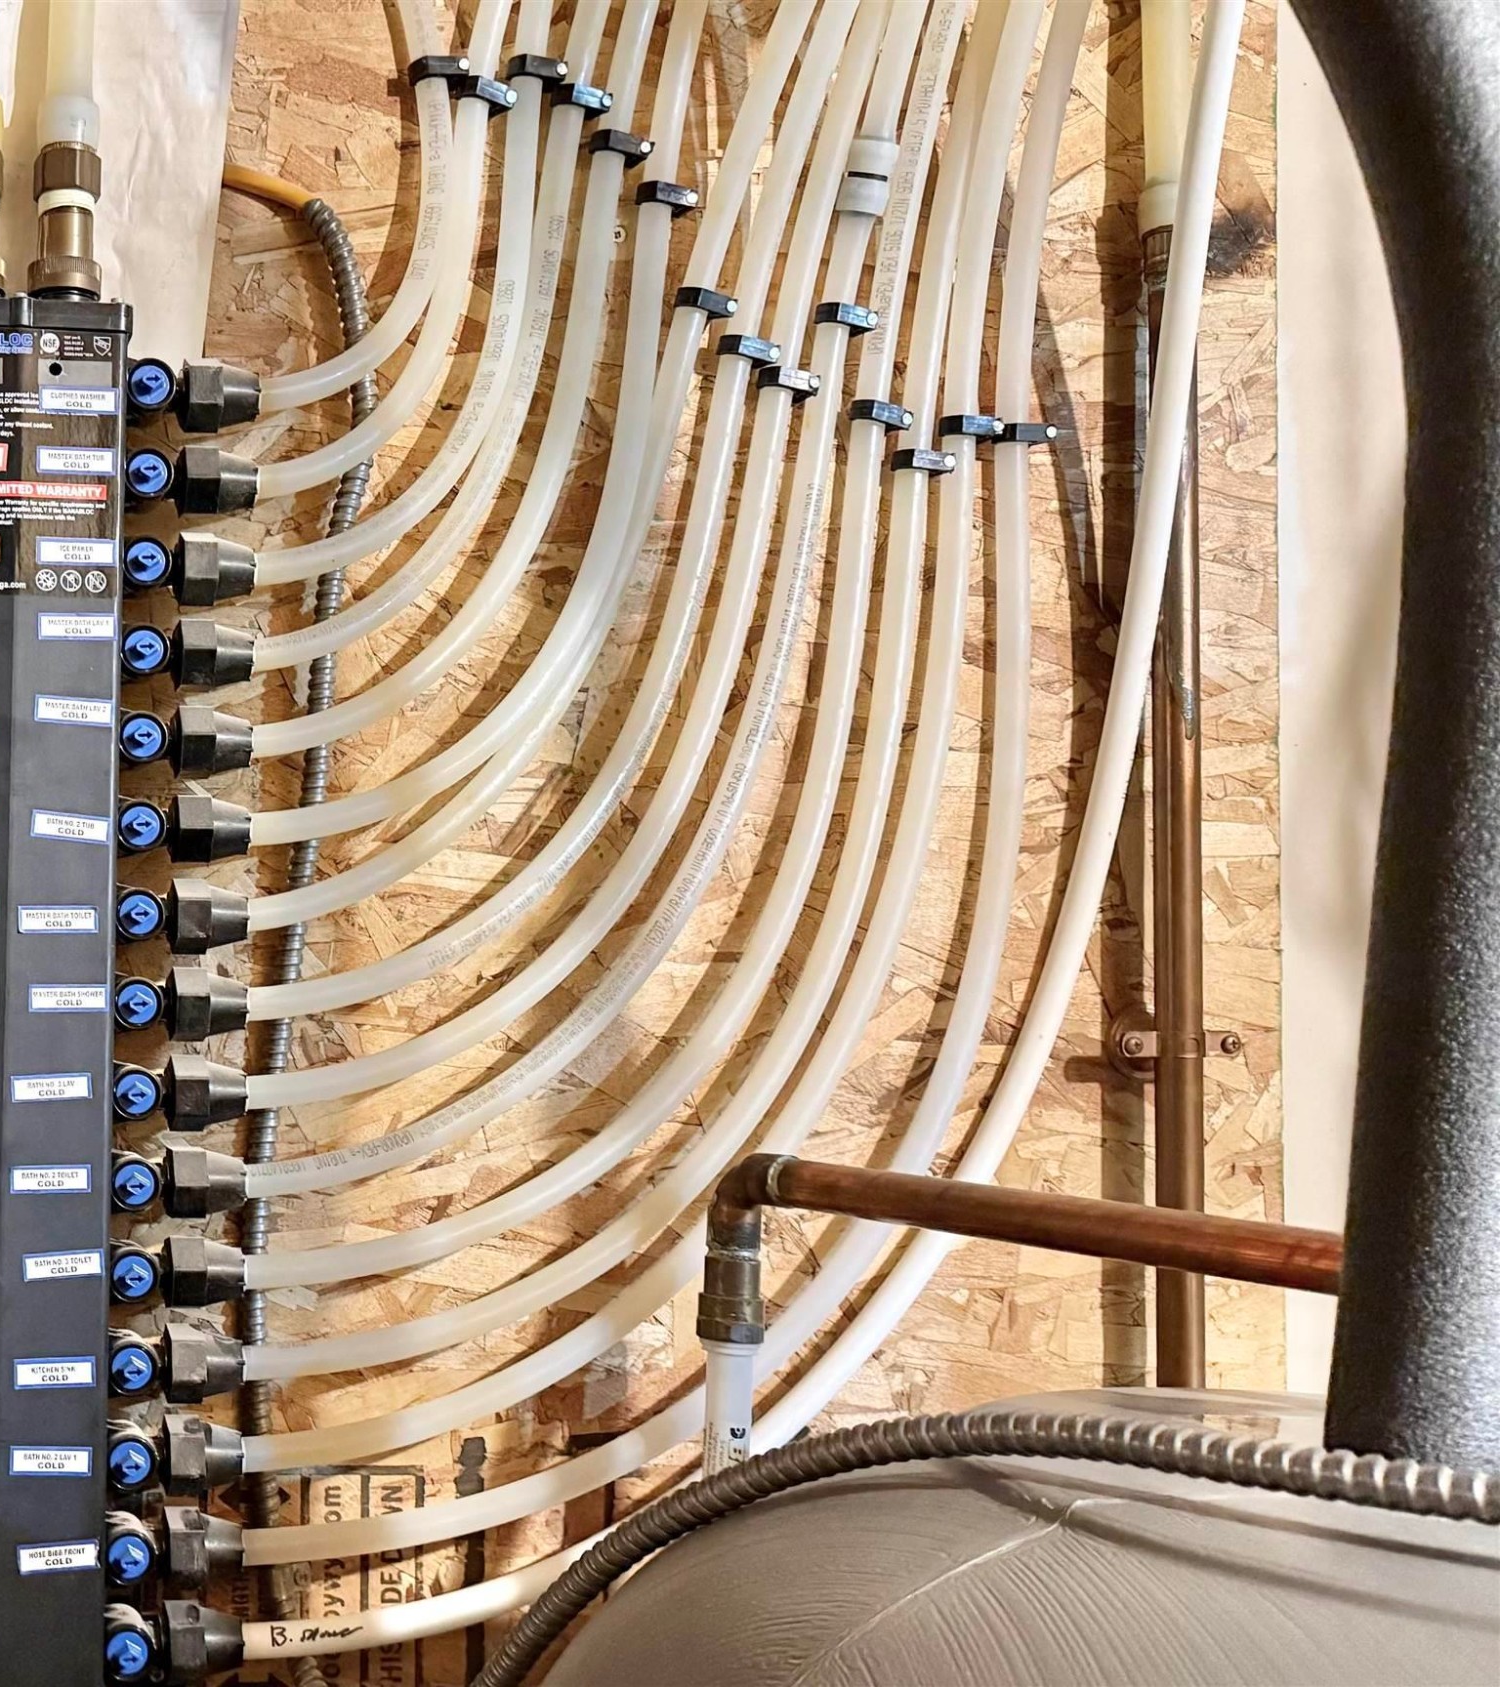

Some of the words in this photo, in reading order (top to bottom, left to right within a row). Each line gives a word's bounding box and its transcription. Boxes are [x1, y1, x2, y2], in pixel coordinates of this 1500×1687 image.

[65, 401, 92, 409] COLD
[35, 485, 103, 498] WARRANTY
[64, 627, 92, 635] COLD
[61, 712, 88, 720] COLD
[57, 827, 84, 837] COLD
[45, 920, 72, 928] COLD
[56, 998, 83, 1006] COLD
[38, 1088, 65, 1097] COLD
[37, 1180, 65, 1188] COLD
[70, 1256, 92, 1265] TOILET
[50, 1265, 78, 1274] COLD
[41, 1374, 68, 1383] COLD
[23, 1453, 40, 1461] BATH
[37, 1461, 65, 1469] COLD
[29, 1550, 46, 1559] HOSE
[64, 1548, 85, 1556] FRONT
[45, 1557, 73, 1566] COLD
[270, 1625, 293, 1647] B.
